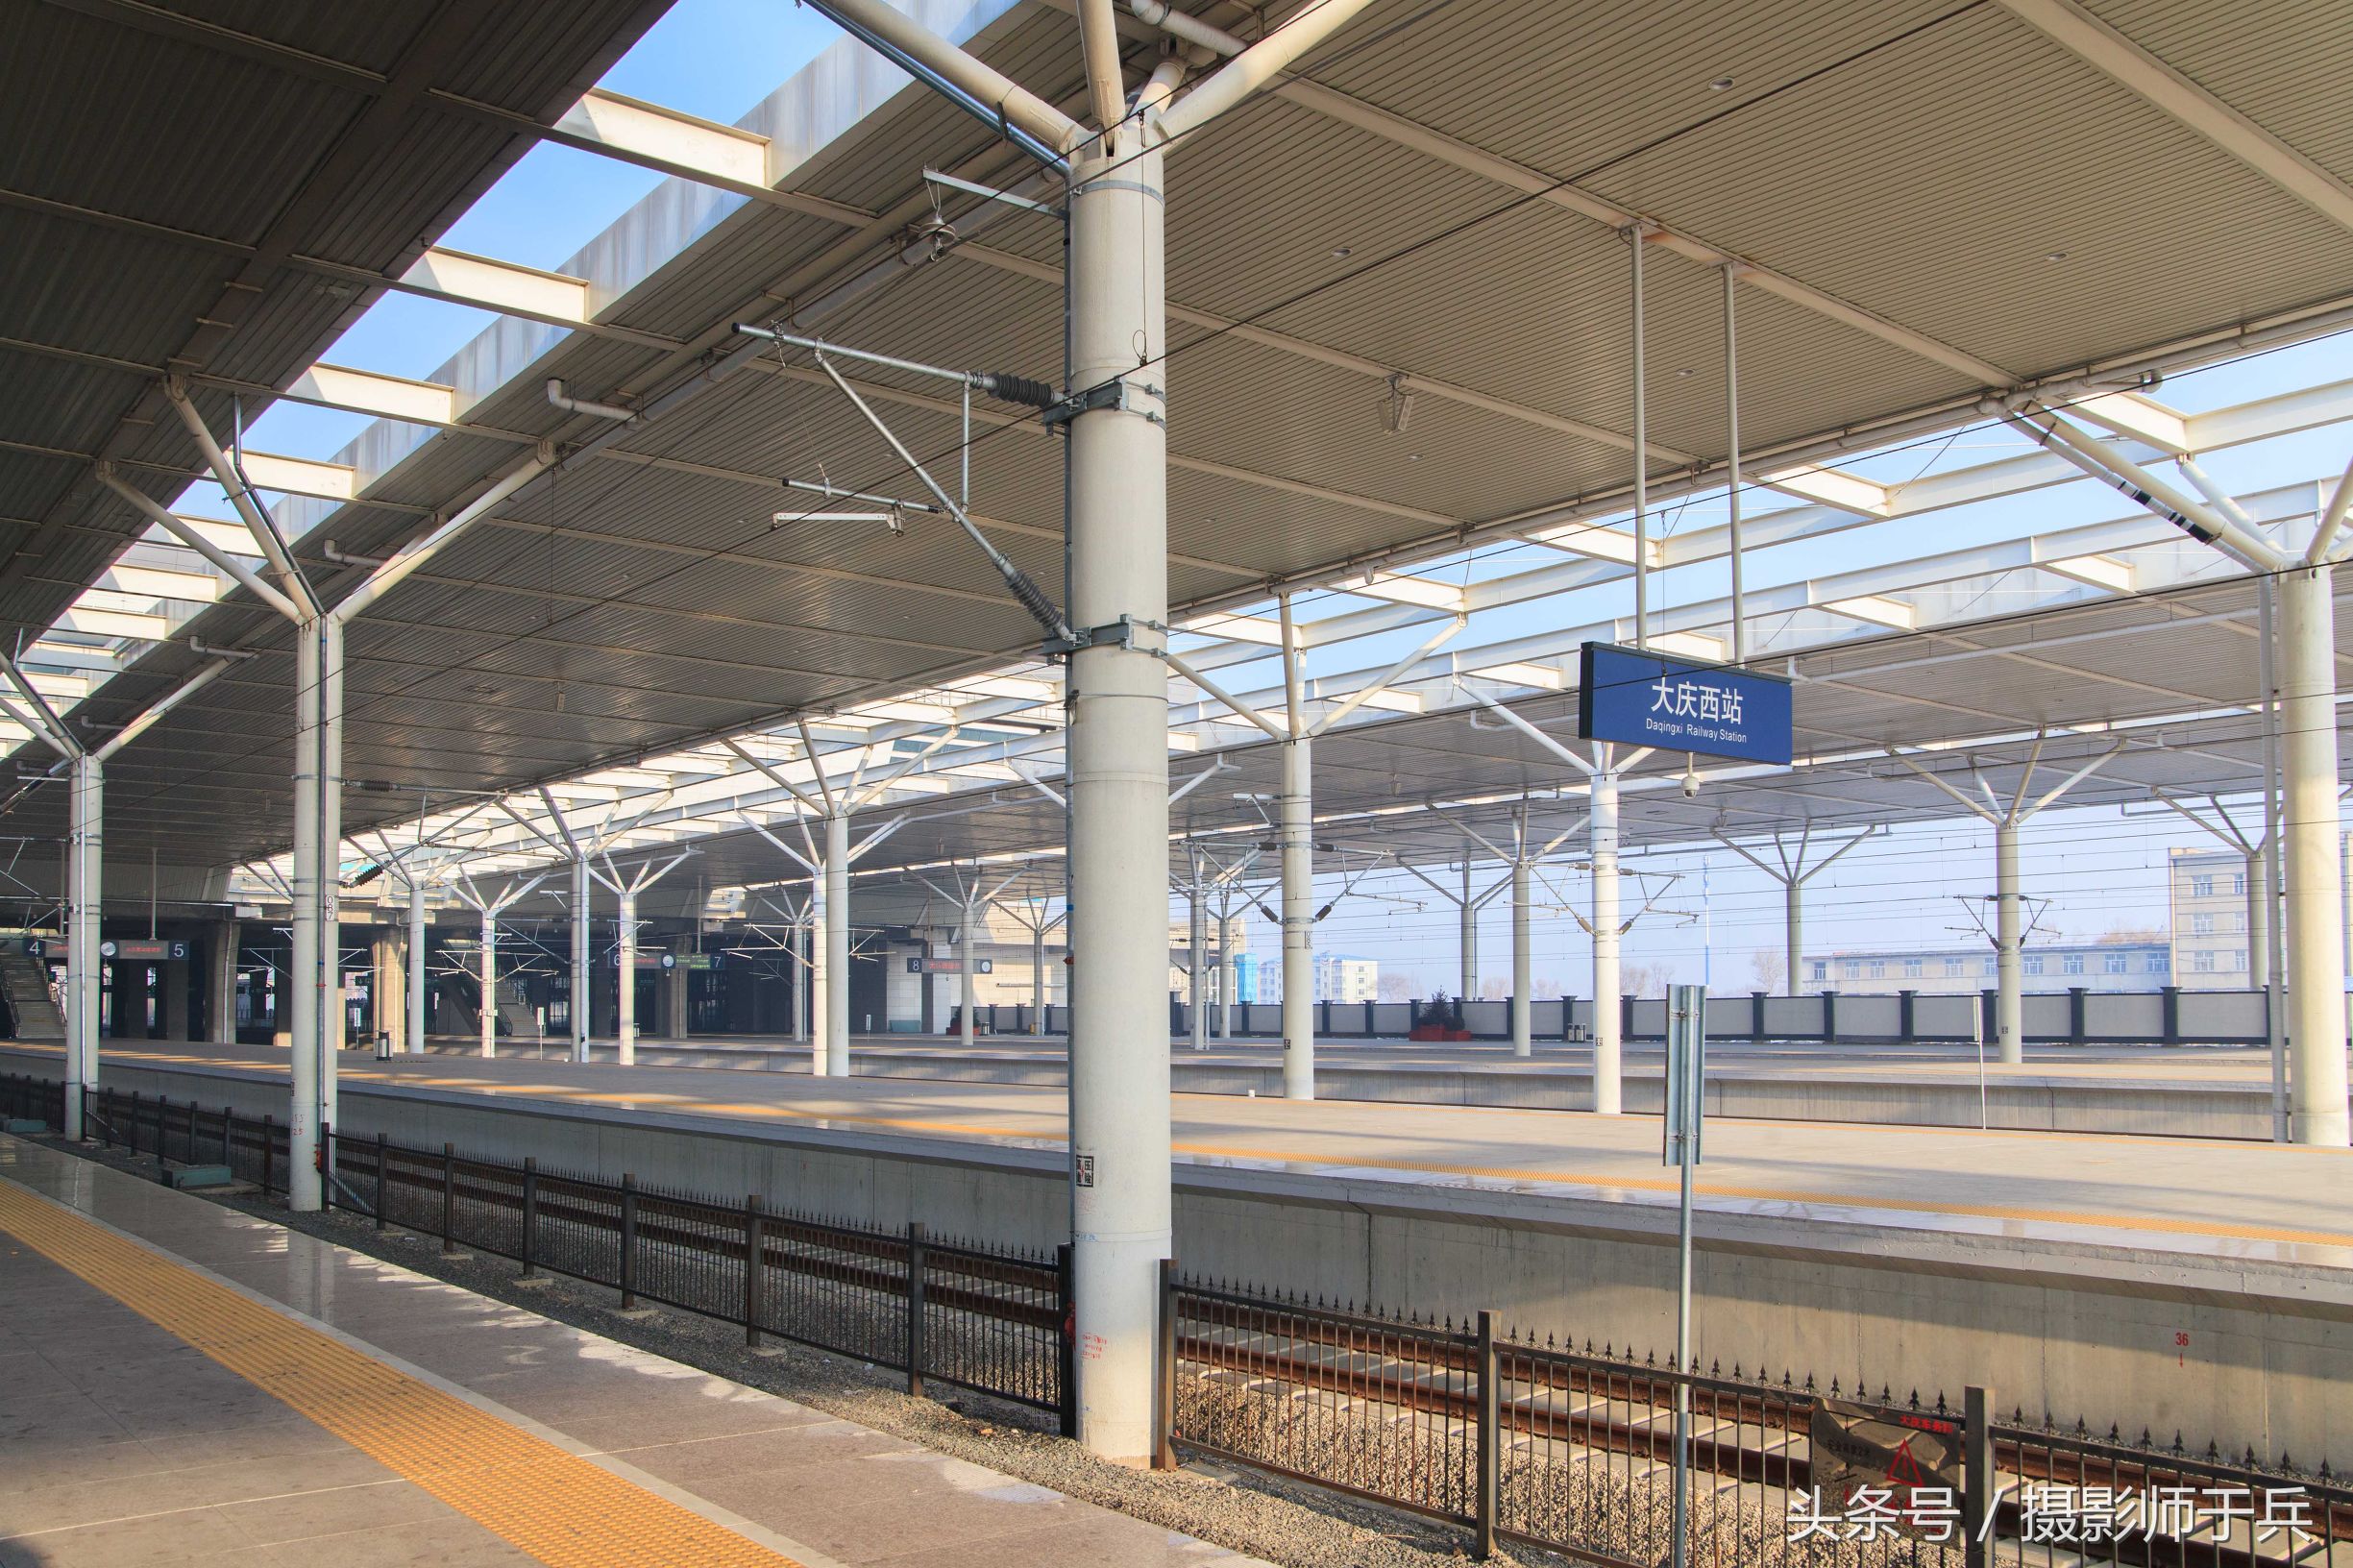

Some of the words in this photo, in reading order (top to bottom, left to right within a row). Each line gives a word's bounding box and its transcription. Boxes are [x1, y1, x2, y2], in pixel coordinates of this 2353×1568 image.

[1651, 676, 1744, 724] 大庆西站
[1646, 718, 1682, 734] Daqingxi
[1686, 723, 1719, 742] Railway
[1720, 728, 1747, 744] Station
[29, 942, 41, 955] 4
[174, 943, 184, 958] 5
[714, 956, 722, 968] 7
[912, 960, 919, 971] 8
[2175, 1332, 2190, 1347] 36
